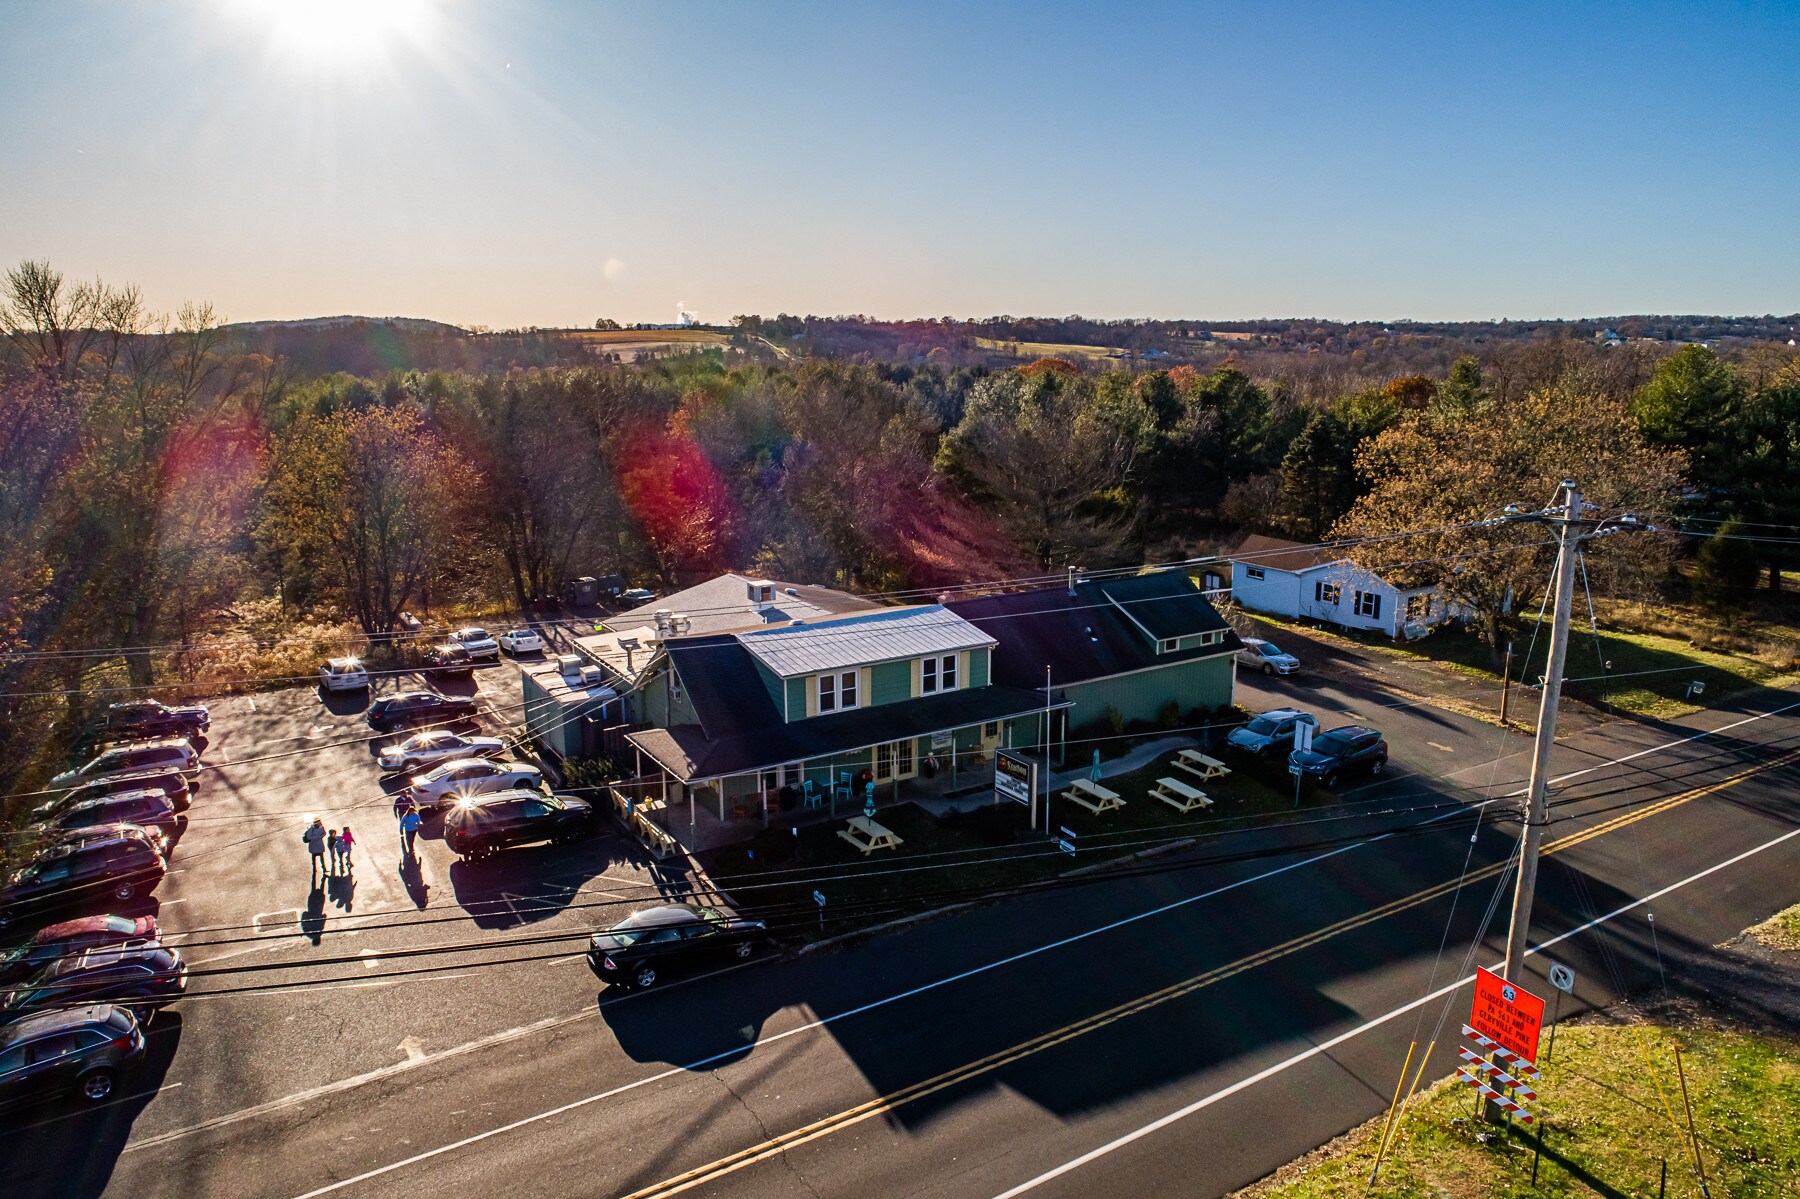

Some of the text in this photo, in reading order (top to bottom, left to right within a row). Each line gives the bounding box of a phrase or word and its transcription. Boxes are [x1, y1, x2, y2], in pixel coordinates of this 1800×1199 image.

[1480, 990, 1535, 1026] CLOSED BETWEEN
[1503, 989, 1514, 1001] 63
[1479, 1009, 1530, 1046] GERYVILLE PIKE
[1488, 1003, 1525, 1031] PA 563 AND
[1477, 1020, 1530, 1056] FOLLOW DETOUR
